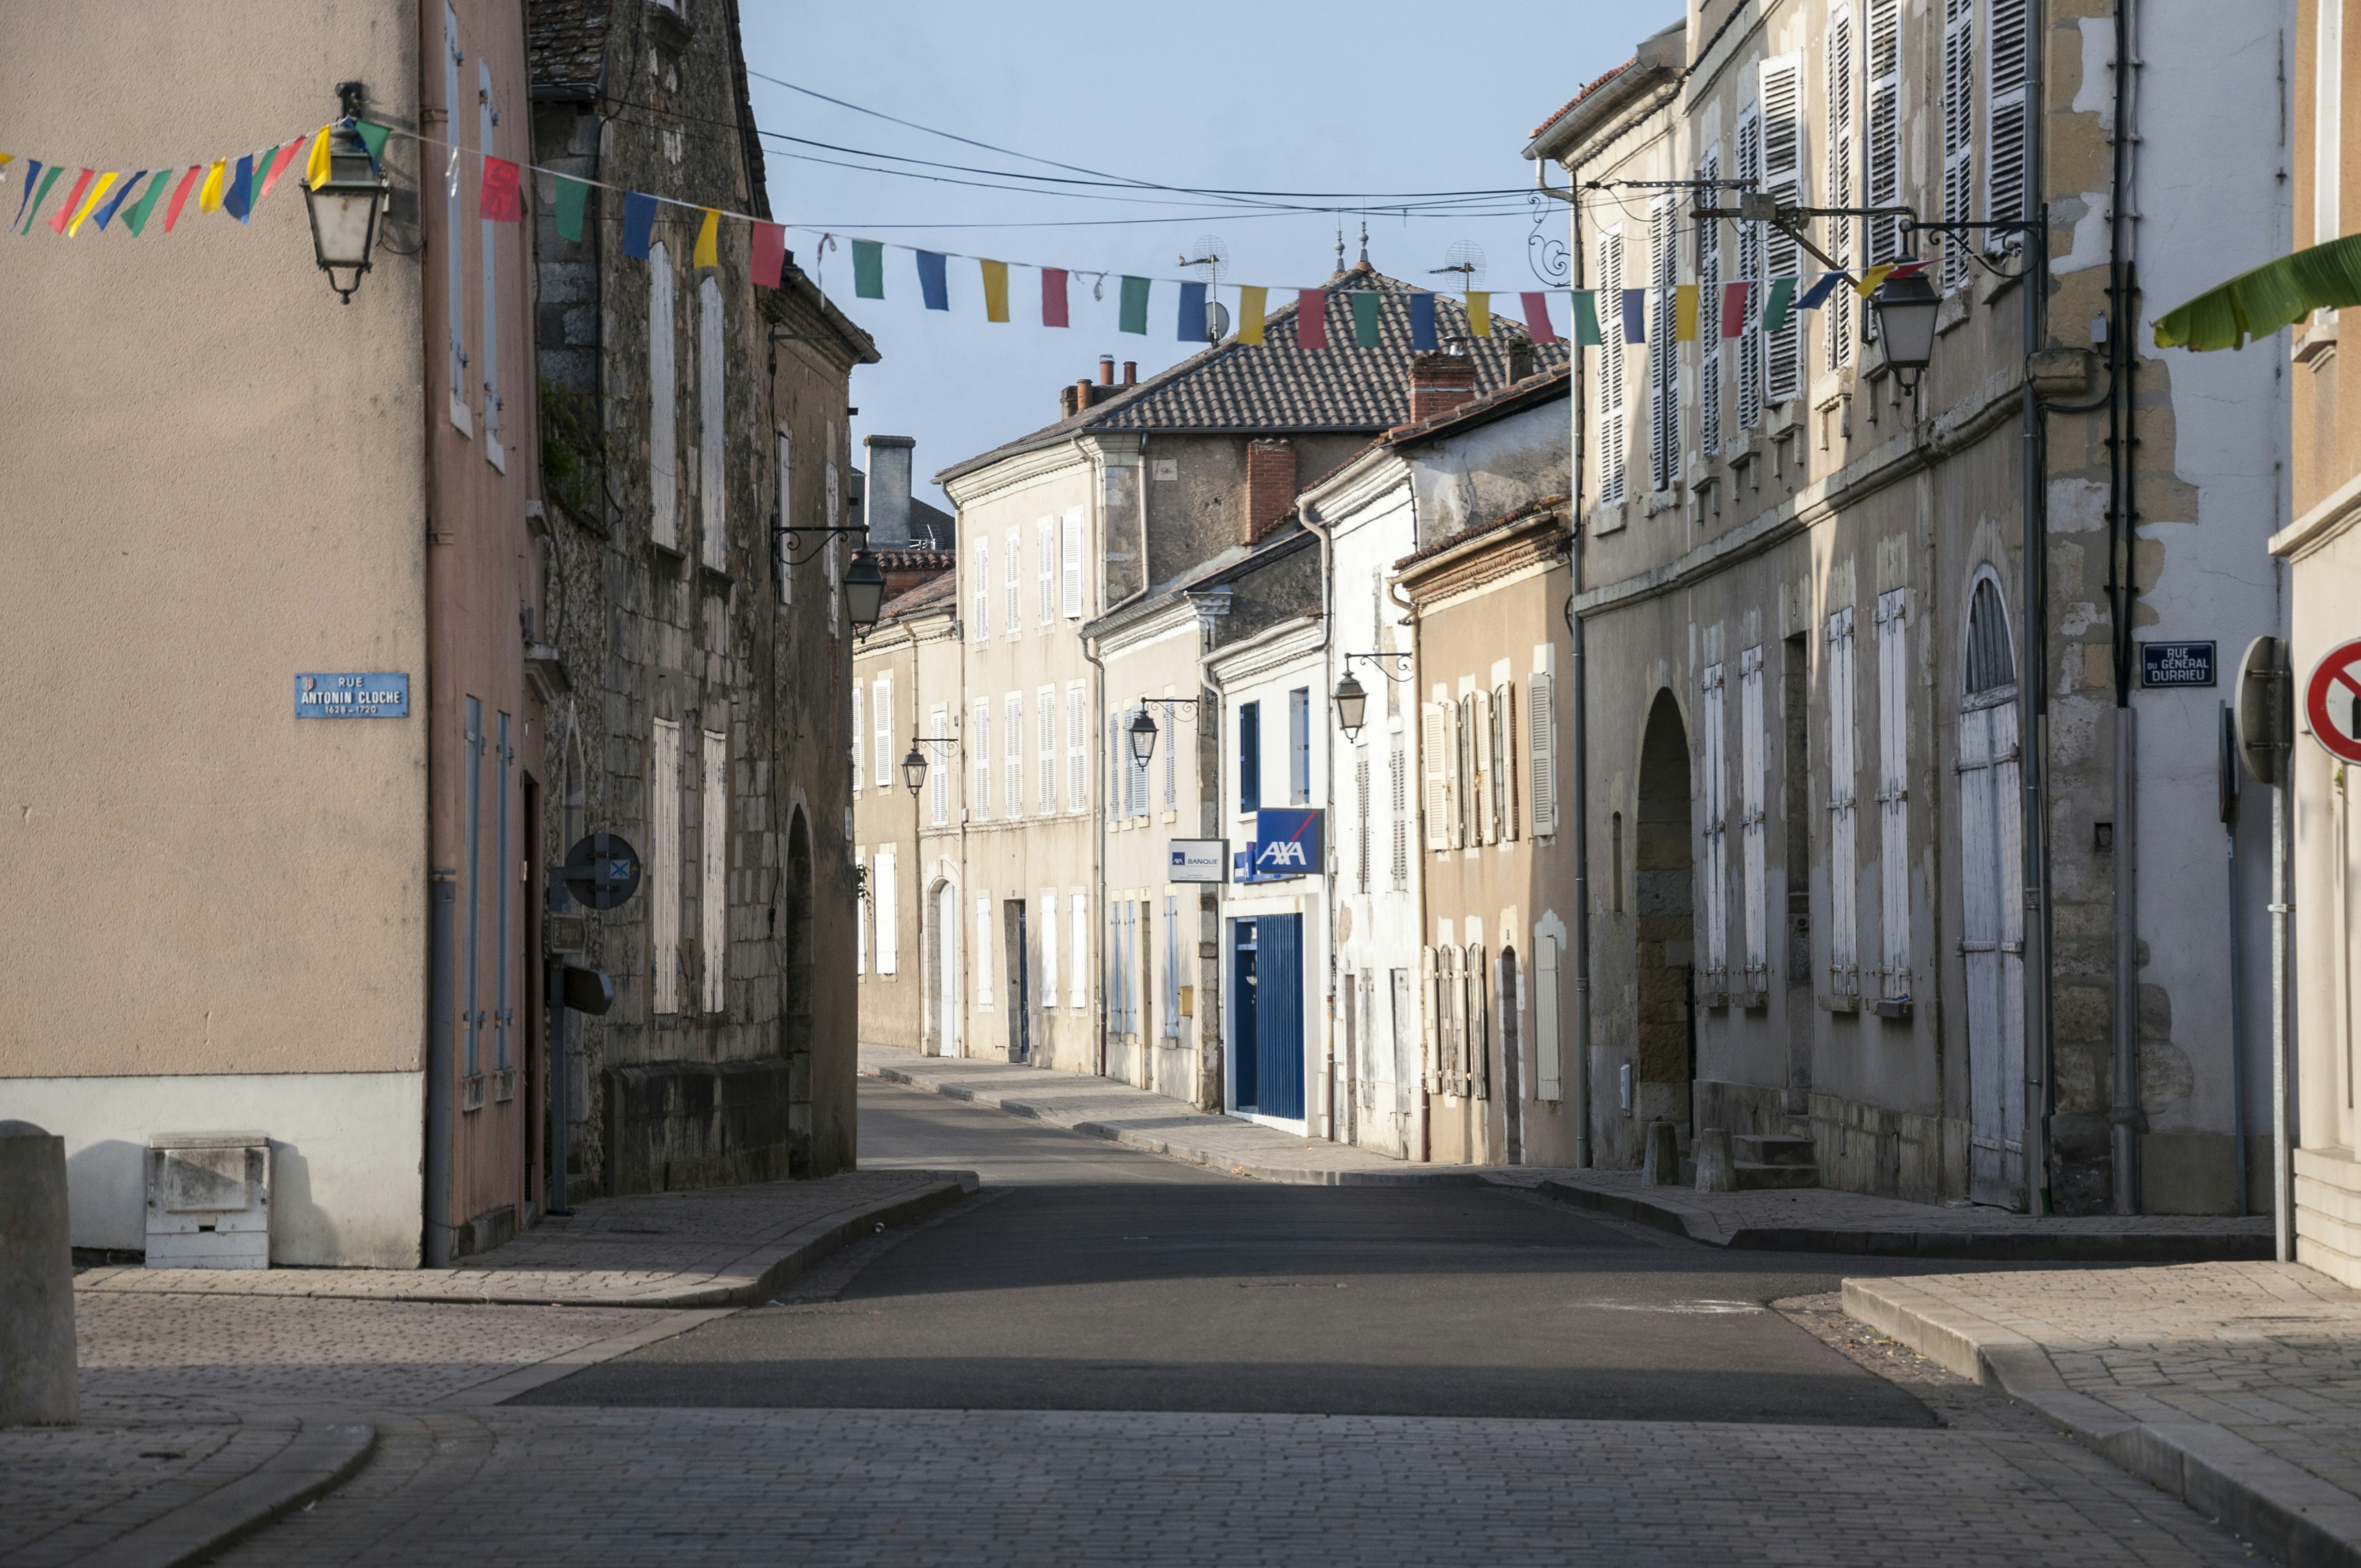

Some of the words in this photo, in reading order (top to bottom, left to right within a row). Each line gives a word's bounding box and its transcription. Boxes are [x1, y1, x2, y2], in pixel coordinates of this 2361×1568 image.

[2167, 648, 2189, 658] RUE
[2162, 657, 2209, 669] GÉNÉRAL
[2152, 669, 2205, 681] DURRIEU
[339, 677, 363, 687] RUE
[301, 691, 352, 704] ANTONIN
[358, 691, 400, 704] CLOCHE
[325, 706, 346, 714] 1628
[356, 705, 377, 714] 1720
[1256, 841, 1307, 865] AXA
